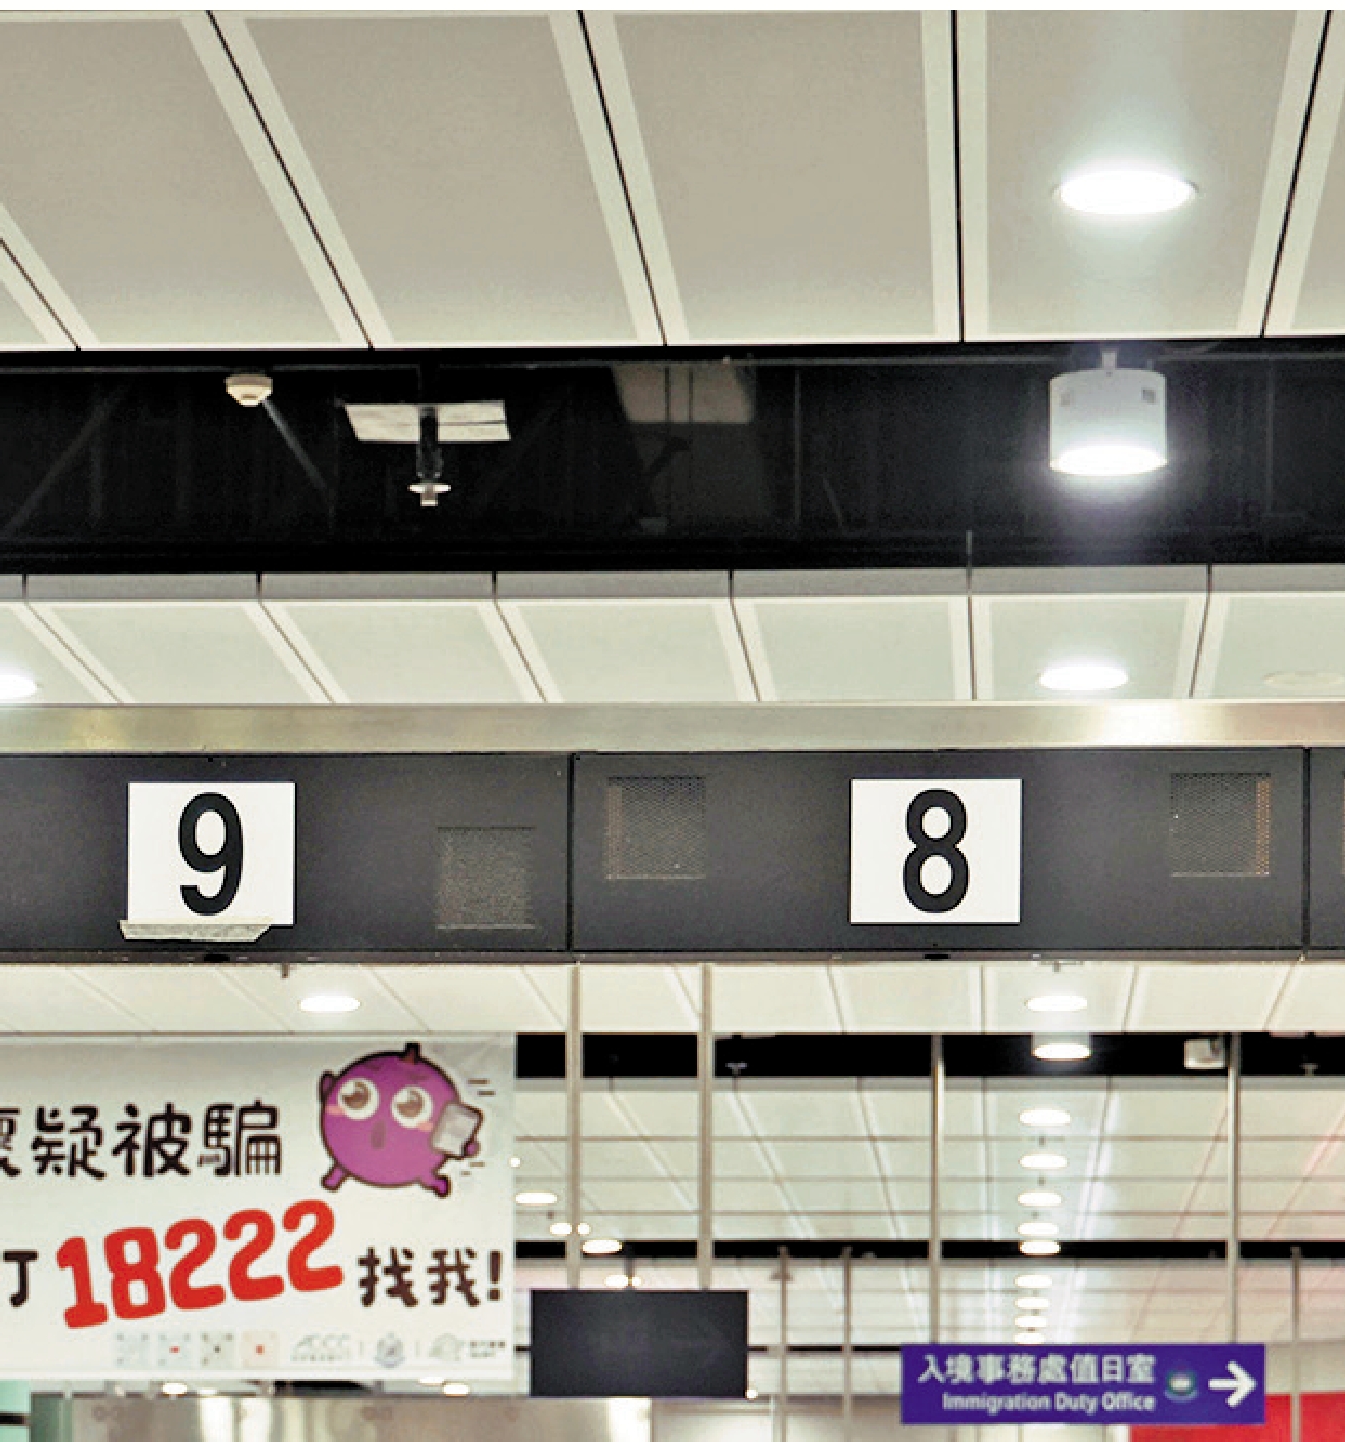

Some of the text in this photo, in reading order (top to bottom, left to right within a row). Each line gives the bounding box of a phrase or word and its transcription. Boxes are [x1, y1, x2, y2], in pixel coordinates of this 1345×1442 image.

[178, 792, 244, 916] 9
[901, 789, 970, 913] 8
[56, 1198, 344, 1329] 18222
[918, 1354, 1156, 1384] 入境事務處值日室
[942, 1391, 1156, 1416] Immigration Duty Office
